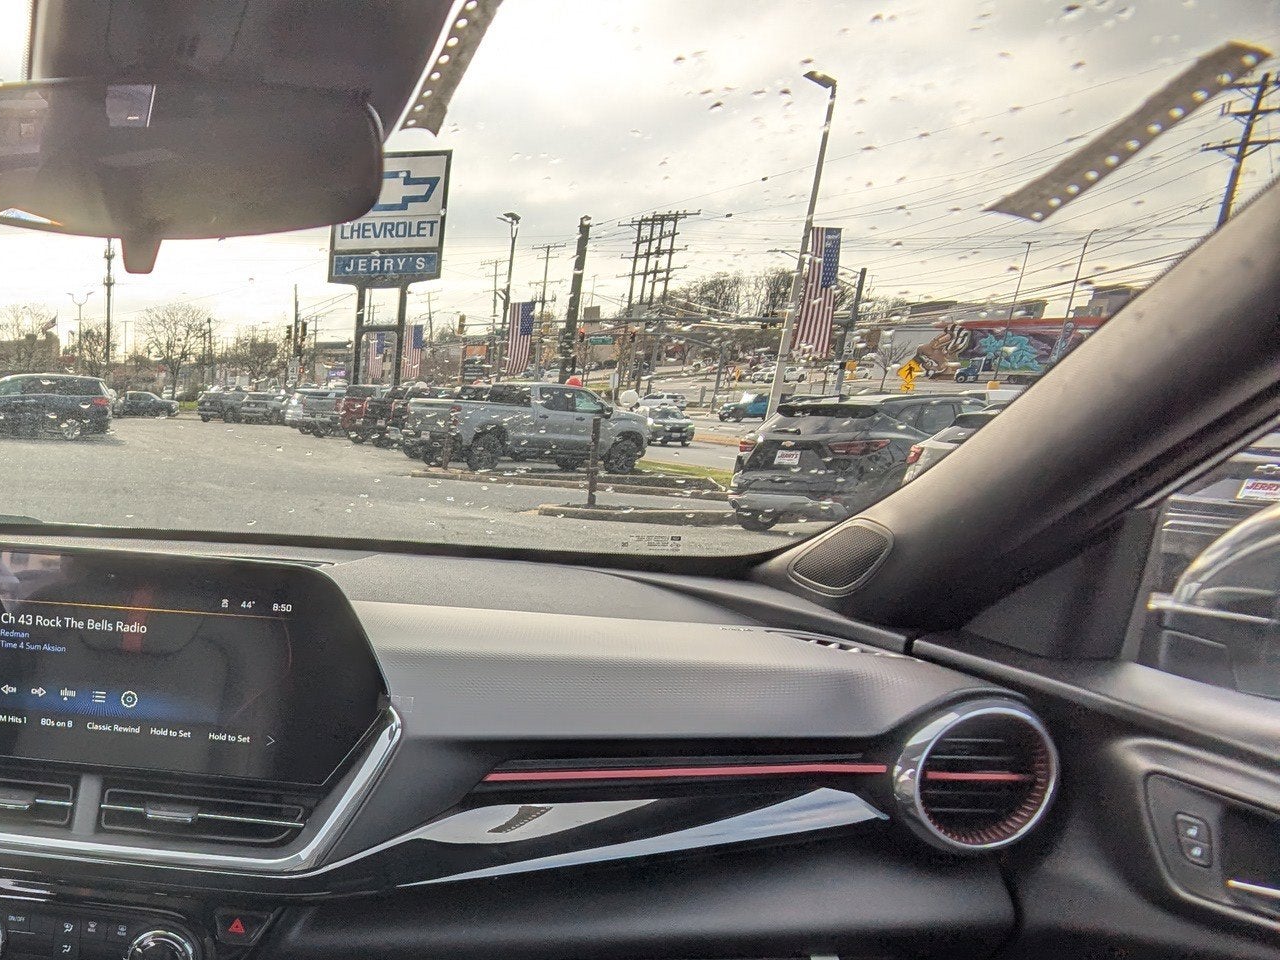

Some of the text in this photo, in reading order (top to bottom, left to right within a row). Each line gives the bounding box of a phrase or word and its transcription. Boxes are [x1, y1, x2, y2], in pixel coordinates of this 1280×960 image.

[340, 220, 438, 239] CHEVROLET
[345, 257, 426, 272] JERRY'S
[273, 603, 292, 612] 8:50
[1, 613, 147, 634] Ch 43 Rock The Bells Radio
[0, 629, 29, 638] Redman
[43, 644, 66, 652] Aksion
[87, 722, 140, 733] Classic Rewind
[150, 728, 167, 736] Hold
[179, 729, 191, 738] Set
[209, 732, 226, 741] Hold
[237, 735, 250, 743] Set
